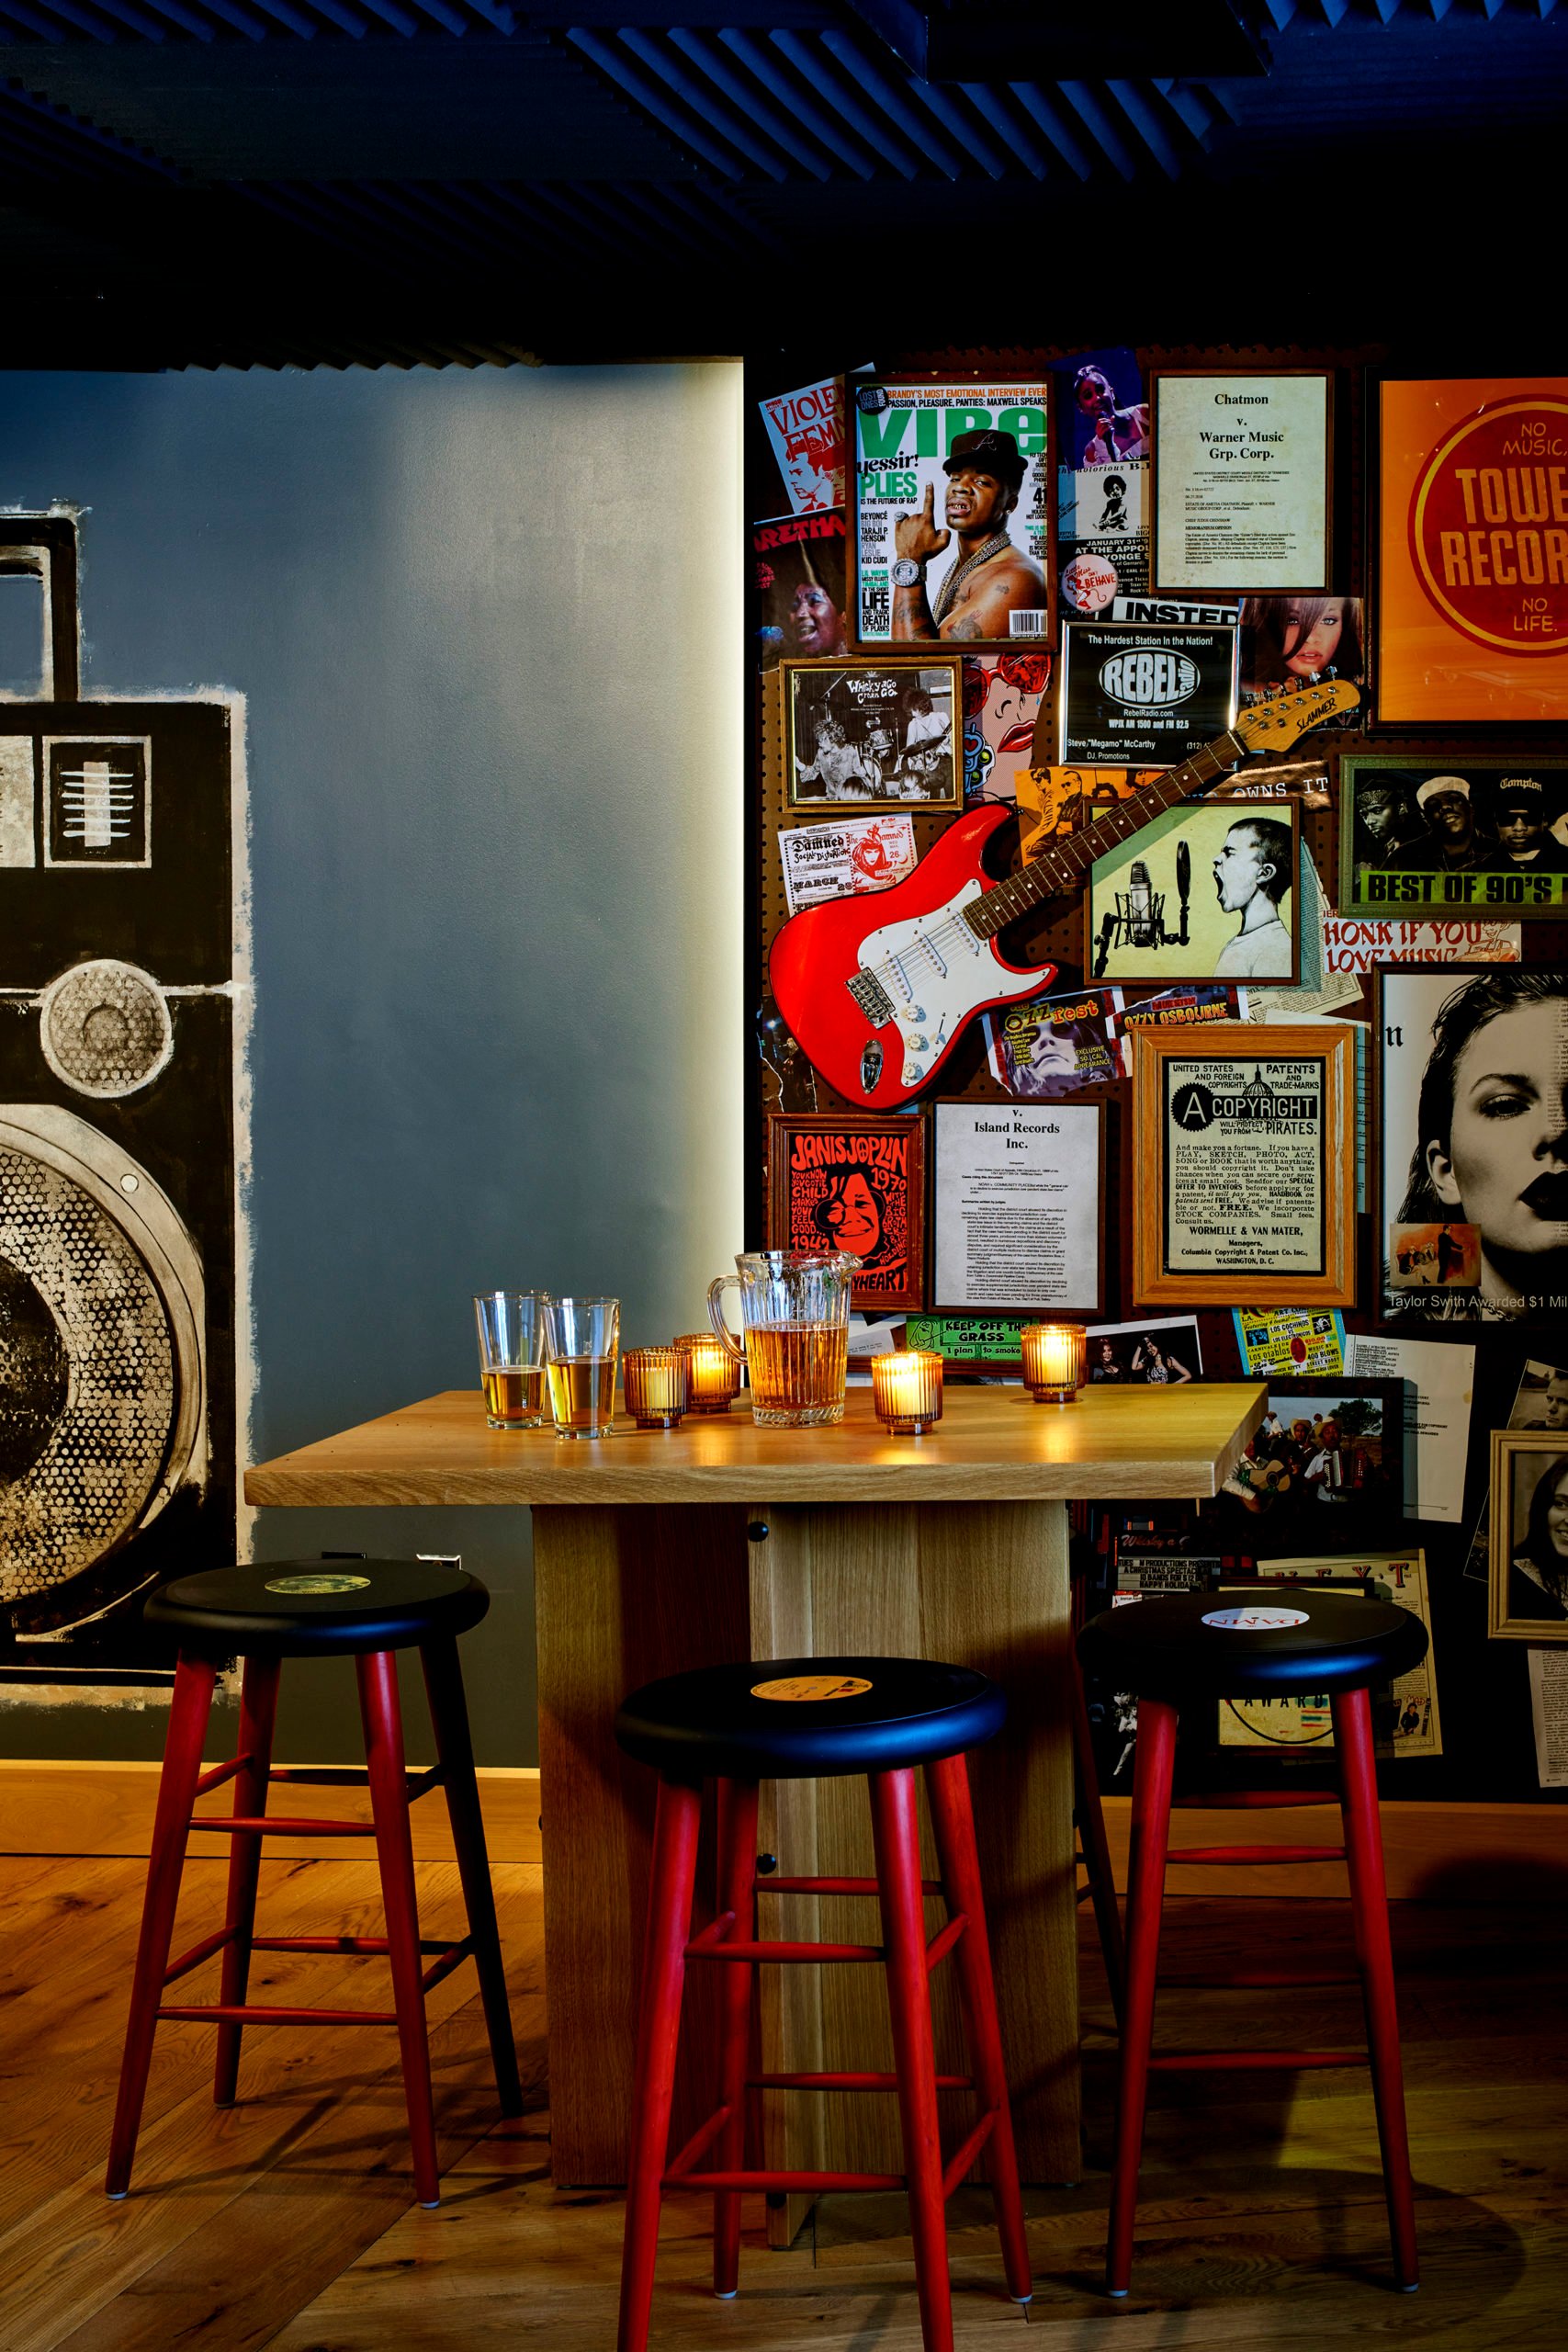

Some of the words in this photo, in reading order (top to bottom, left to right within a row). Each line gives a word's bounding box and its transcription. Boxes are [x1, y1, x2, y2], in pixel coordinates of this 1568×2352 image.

[887, 390, 922, 399] BRANDY'S
[924, 390, 944, 398] MOST
[946, 389, 987, 398] EMOTIONAL
[988, 389, 1026, 397] INTERVIEW
[1028, 388, 1047, 397] EVER
[1214, 394, 1269, 404] Chatmon
[887, 399, 918, 408] PASSION,
[919, 399, 954, 408] PLEASURE,
[956, 398, 985, 407] PANTIES:
[987, 398, 1019, 406] MAXWELL
[1021, 397, 1047, 405] SPEAKS
[1522, 422, 1547, 437] NO
[1200, 432, 1245, 443] Warner
[1248, 431, 1284, 442] Music
[1503, 439, 1568, 456] MUSIC,
[1209, 448, 1237, 461] Grp.
[1240, 447, 1274, 461] Corp.
[857, 451, 919, 479] yessir!
[861, 471, 918, 497] PLIES
[861, 511, 887, 520] BEYONCÉ
[1085, 573, 1116, 589] BEHAVE
[862, 593, 889, 609] LIFE
[1522, 597, 1548, 612] NO
[863, 616, 889, 625] DEATH
[1514, 616, 1558, 632] LIFE.
[1089, 635, 1102, 643] The
[1104, 636, 1133, 645] Hardest
[1135, 636, 1161, 645] Station
[1164, 637, 1170, 645] In
[1173, 637, 1184, 645] the
[1186, 637, 1213, 645] Nation!
[1104, 653, 1179, 703] REBEL
[1297, 697, 1337, 733] SLAMMER
[1126, 719, 1134, 729] AM
[1137, 720, 1151, 729] 1500
[1153, 720, 1164, 729] and
[1166, 720, 1174, 729] FM
[1176, 720, 1189, 729] 92.5
[1124, 741, 1156, 749] McCarthy
[1303, 777, 1329, 794] IT
[1500, 778, 1542, 792] Compton
[793, 835, 844, 853] Damned
[794, 877, 839, 889] MARCH
[1368, 875, 1436, 902] BEST
[1444, 876, 1477, 902] OF
[1486, 876, 1552, 903] 90'S
[1324, 922, 1394, 946] HONK
[1399, 921, 1424, 945] IF
[1429, 920, 1482, 944] YOU
[1160, 1002, 1228, 1024] OSBOURNE
[1076, 1046, 1104, 1056] EXCLUSIVE
[1074, 1058, 1111, 1069] APPEARANCE
[1266, 1065, 1315, 1074] PATENTS
[1183, 1091, 1206, 1123] A
[1213, 1098, 1313, 1117] COPYRIGHT
[975, 1122, 1010, 1132] Island
[1013, 1123, 1060, 1133] Records
[1266, 1122, 1317, 1135] PIRATES.
[1006, 1138, 1028, 1148] Inc.
[791, 1135, 846, 1170] JANIS
[846, 1136, 908, 1176] JOPLIN
[871, 1168, 907, 1191] 1970
[792, 1187, 829, 1198] CHILD
[1190, 1227, 1236, 1235] WORMELLE
[1241, 1227, 1247, 1235] &
[1252, 1227, 1269, 1235] VAN
[1271, 1227, 1303, 1237] MATER,
[1389, 1295, 1427, 1309] Taylor
[1430, 1295, 1465, 1307] Swith
[1470, 1295, 1525, 1307] Awarded
[1529, 1295, 1545, 1308] $1
[946, 1321, 976, 1331] KEEP
[979, 1321, 1002, 1330] OFF
[959, 1332, 1005, 1341] GRASS
[954, 1347, 973, 1356] plan
[1319, 1349, 1338, 1358] BLOWS
[1140, 1580, 1162, 1589] HAPPY
